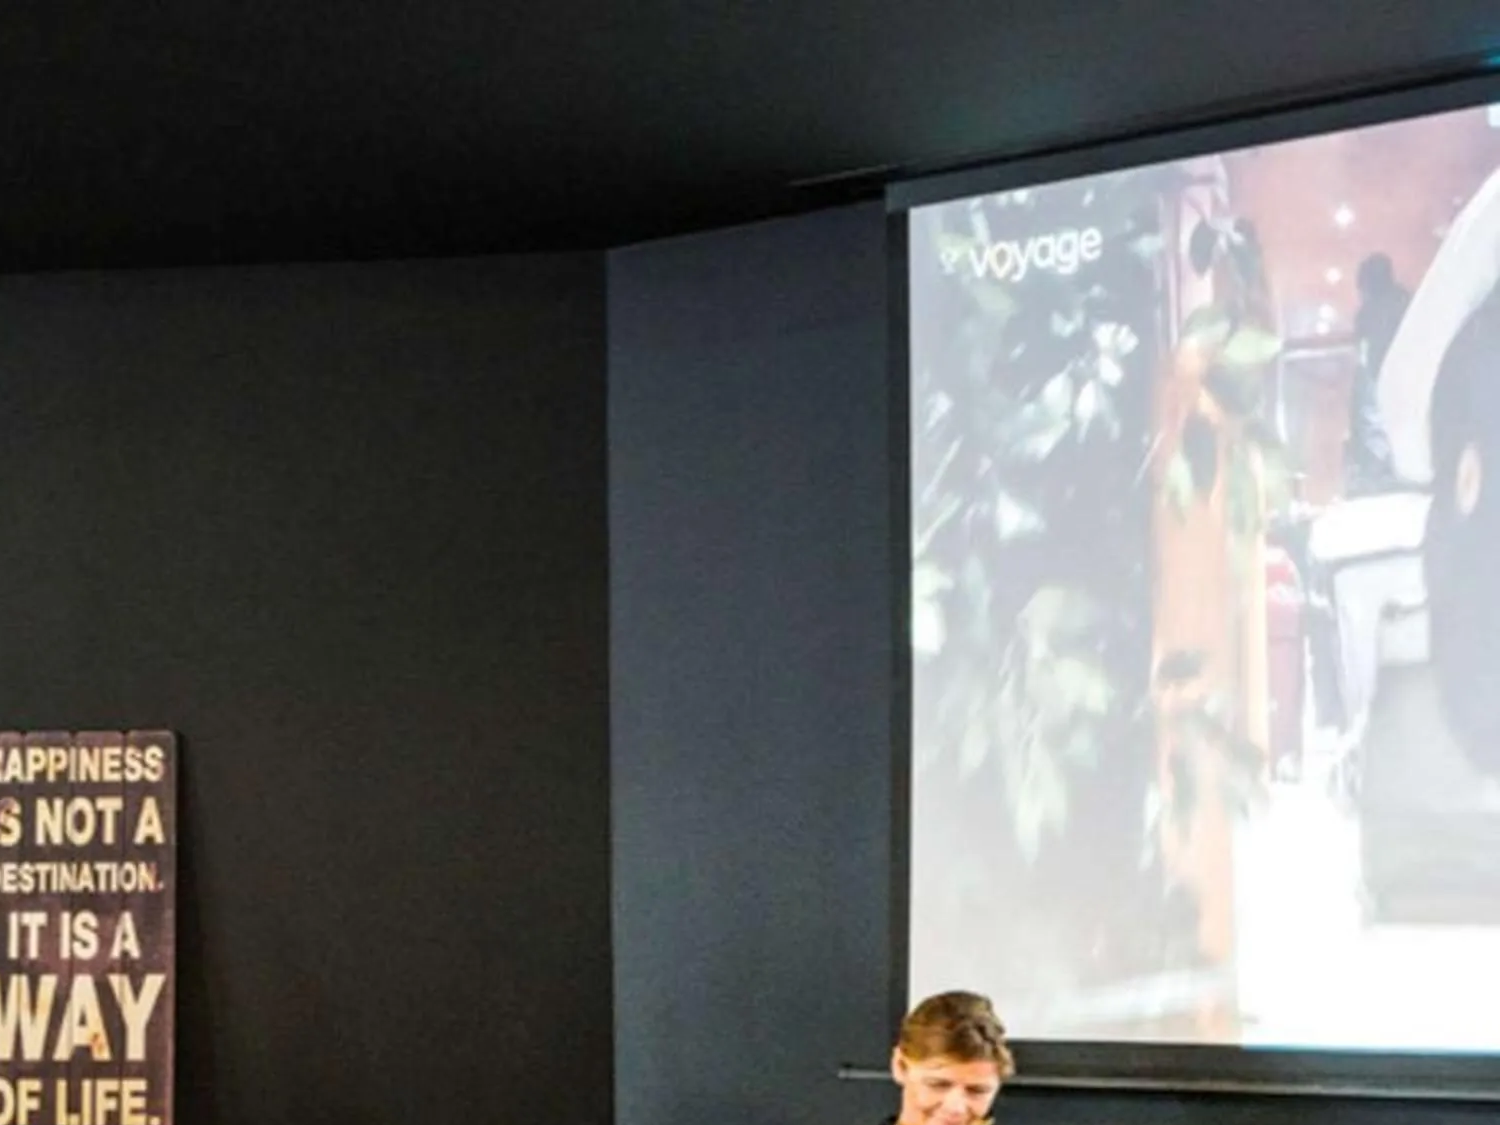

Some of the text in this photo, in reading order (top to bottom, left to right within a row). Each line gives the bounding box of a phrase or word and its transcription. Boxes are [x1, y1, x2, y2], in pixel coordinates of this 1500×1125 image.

[969, 227, 1103, 283] voyage
[35, 796, 124, 846] NOT
[134, 796, 165, 845] A
[8, 911, 141, 960] IT IS A
